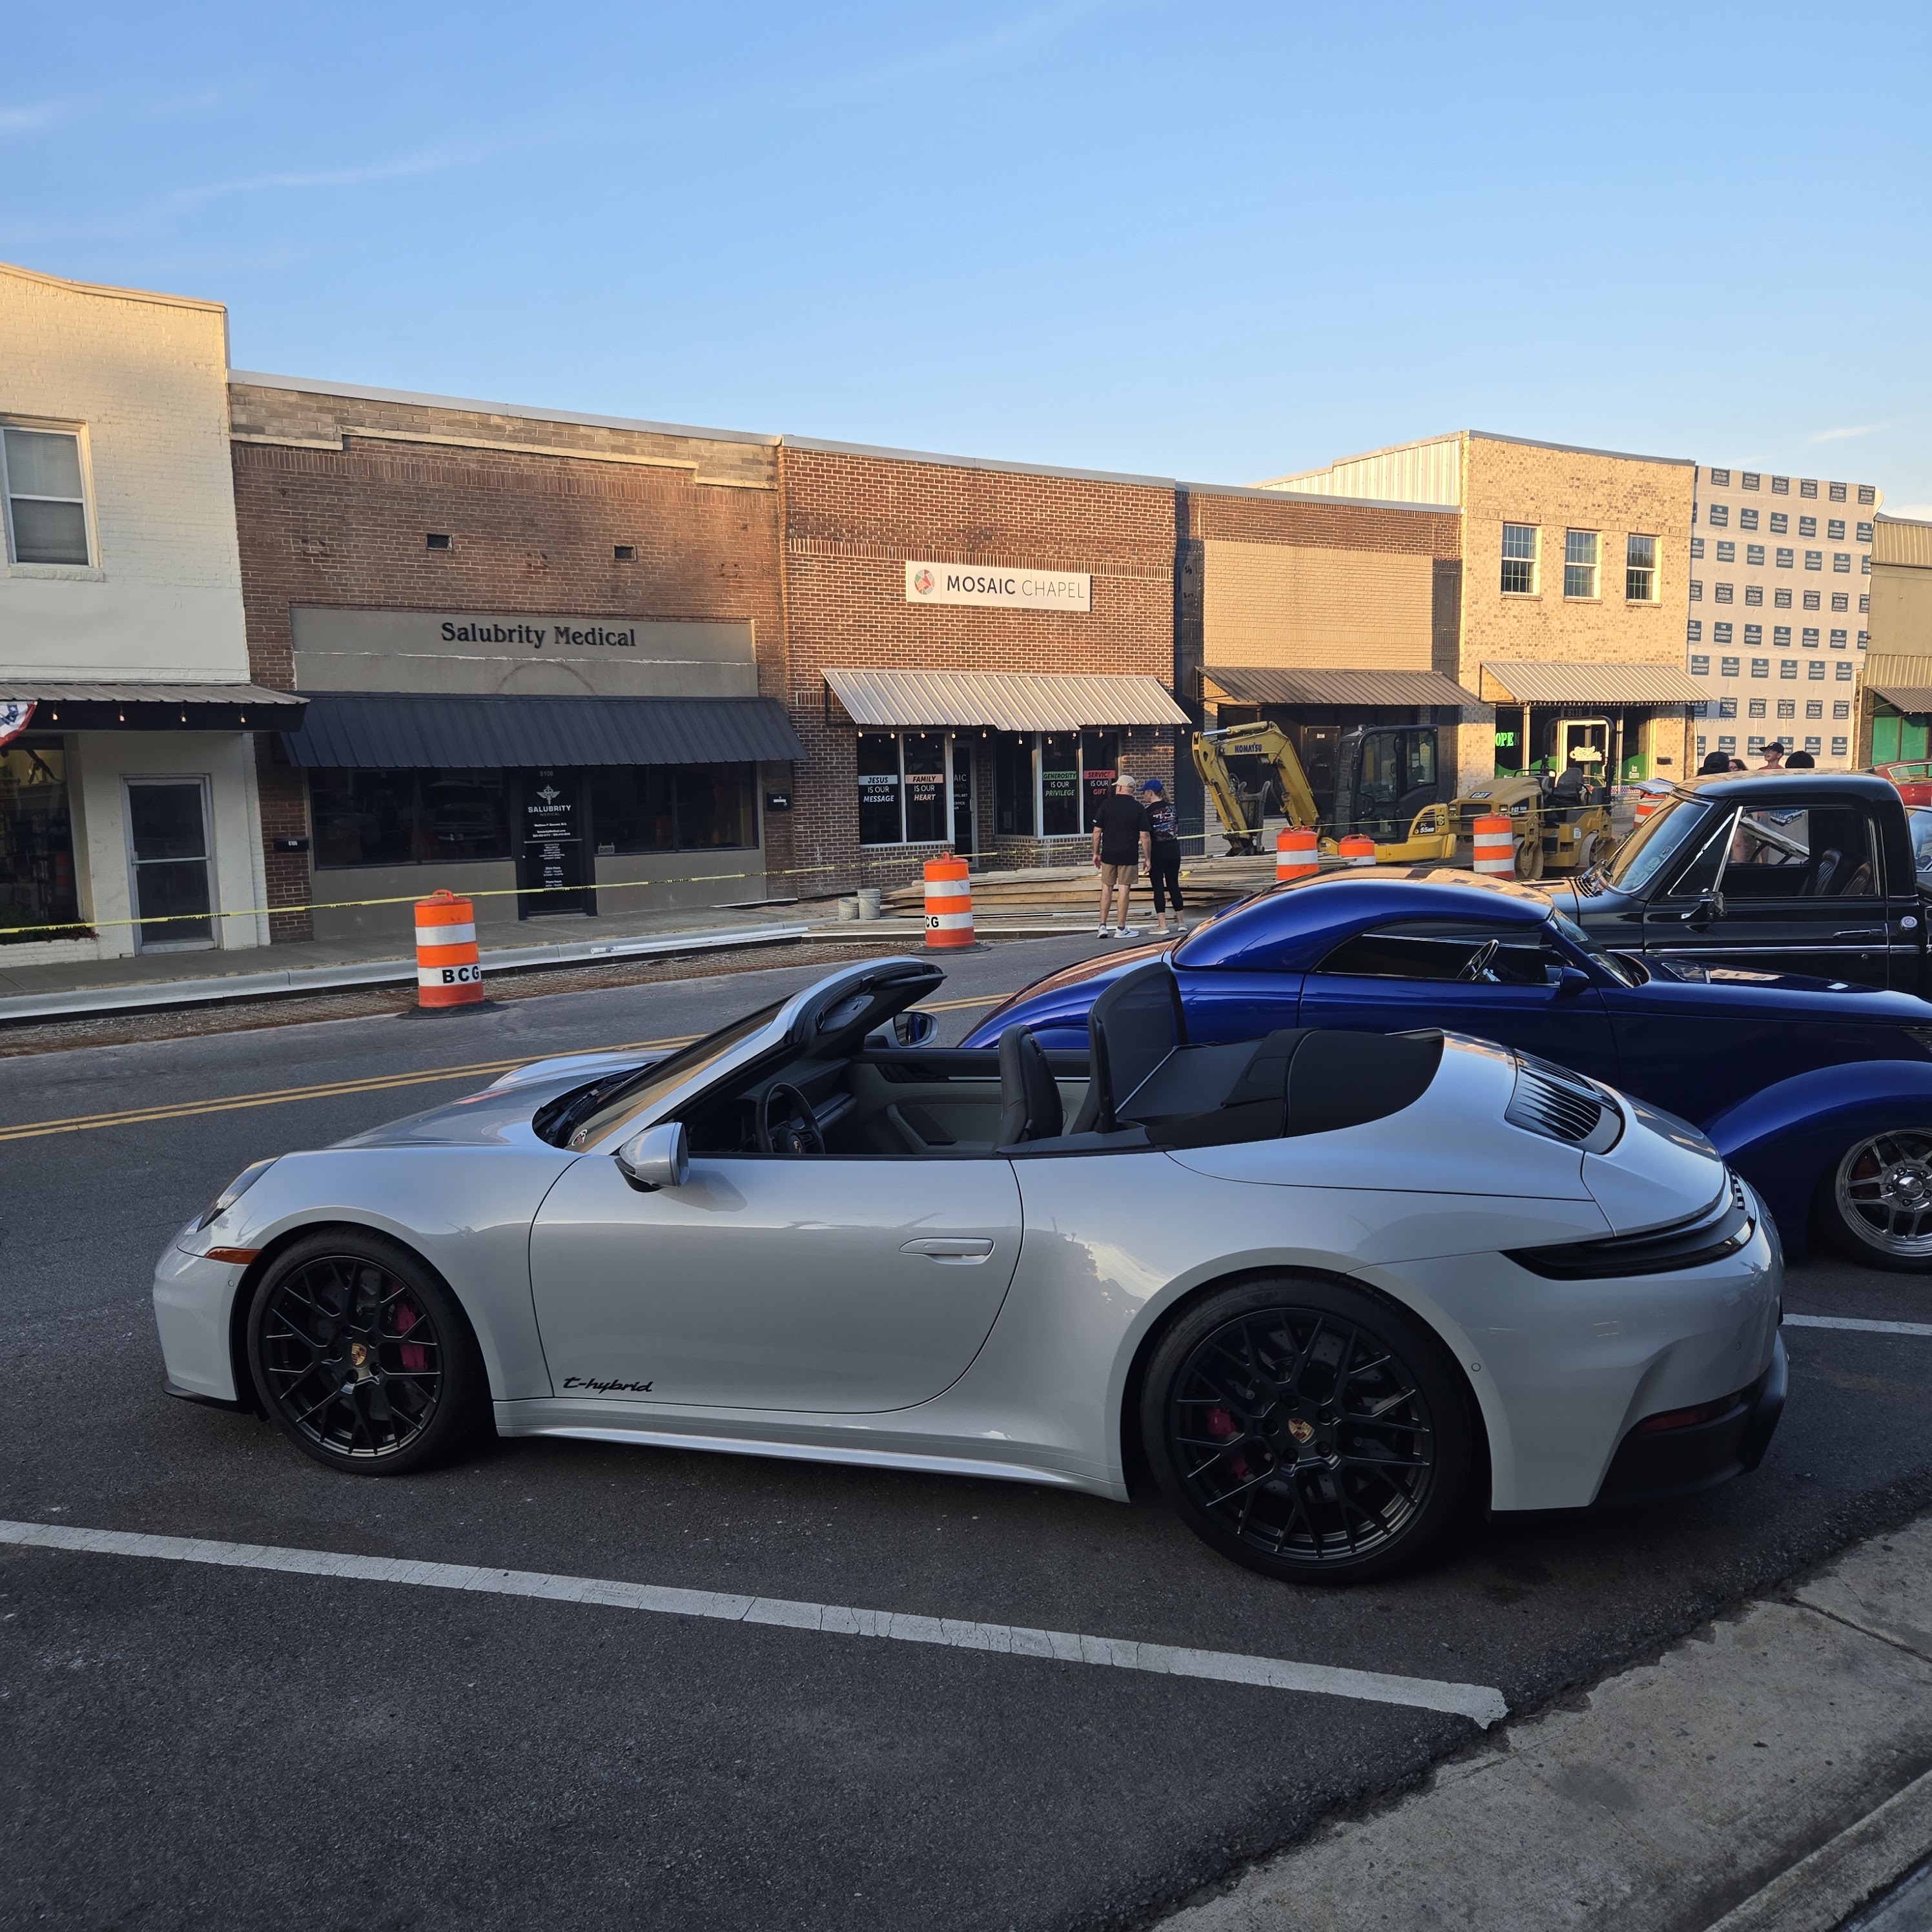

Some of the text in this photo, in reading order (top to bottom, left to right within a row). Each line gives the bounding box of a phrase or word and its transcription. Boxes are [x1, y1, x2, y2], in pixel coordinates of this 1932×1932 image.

[947, 575, 1085, 598] MOSAIC CHAPEL
[441, 622, 636, 648] Salubrity Medical
[1235, 742, 1262, 753] KOMATSU
[926, 916, 939, 928] CG
[442, 966, 479, 983] BCG
[563, 1377, 653, 1394] t-hybrid
